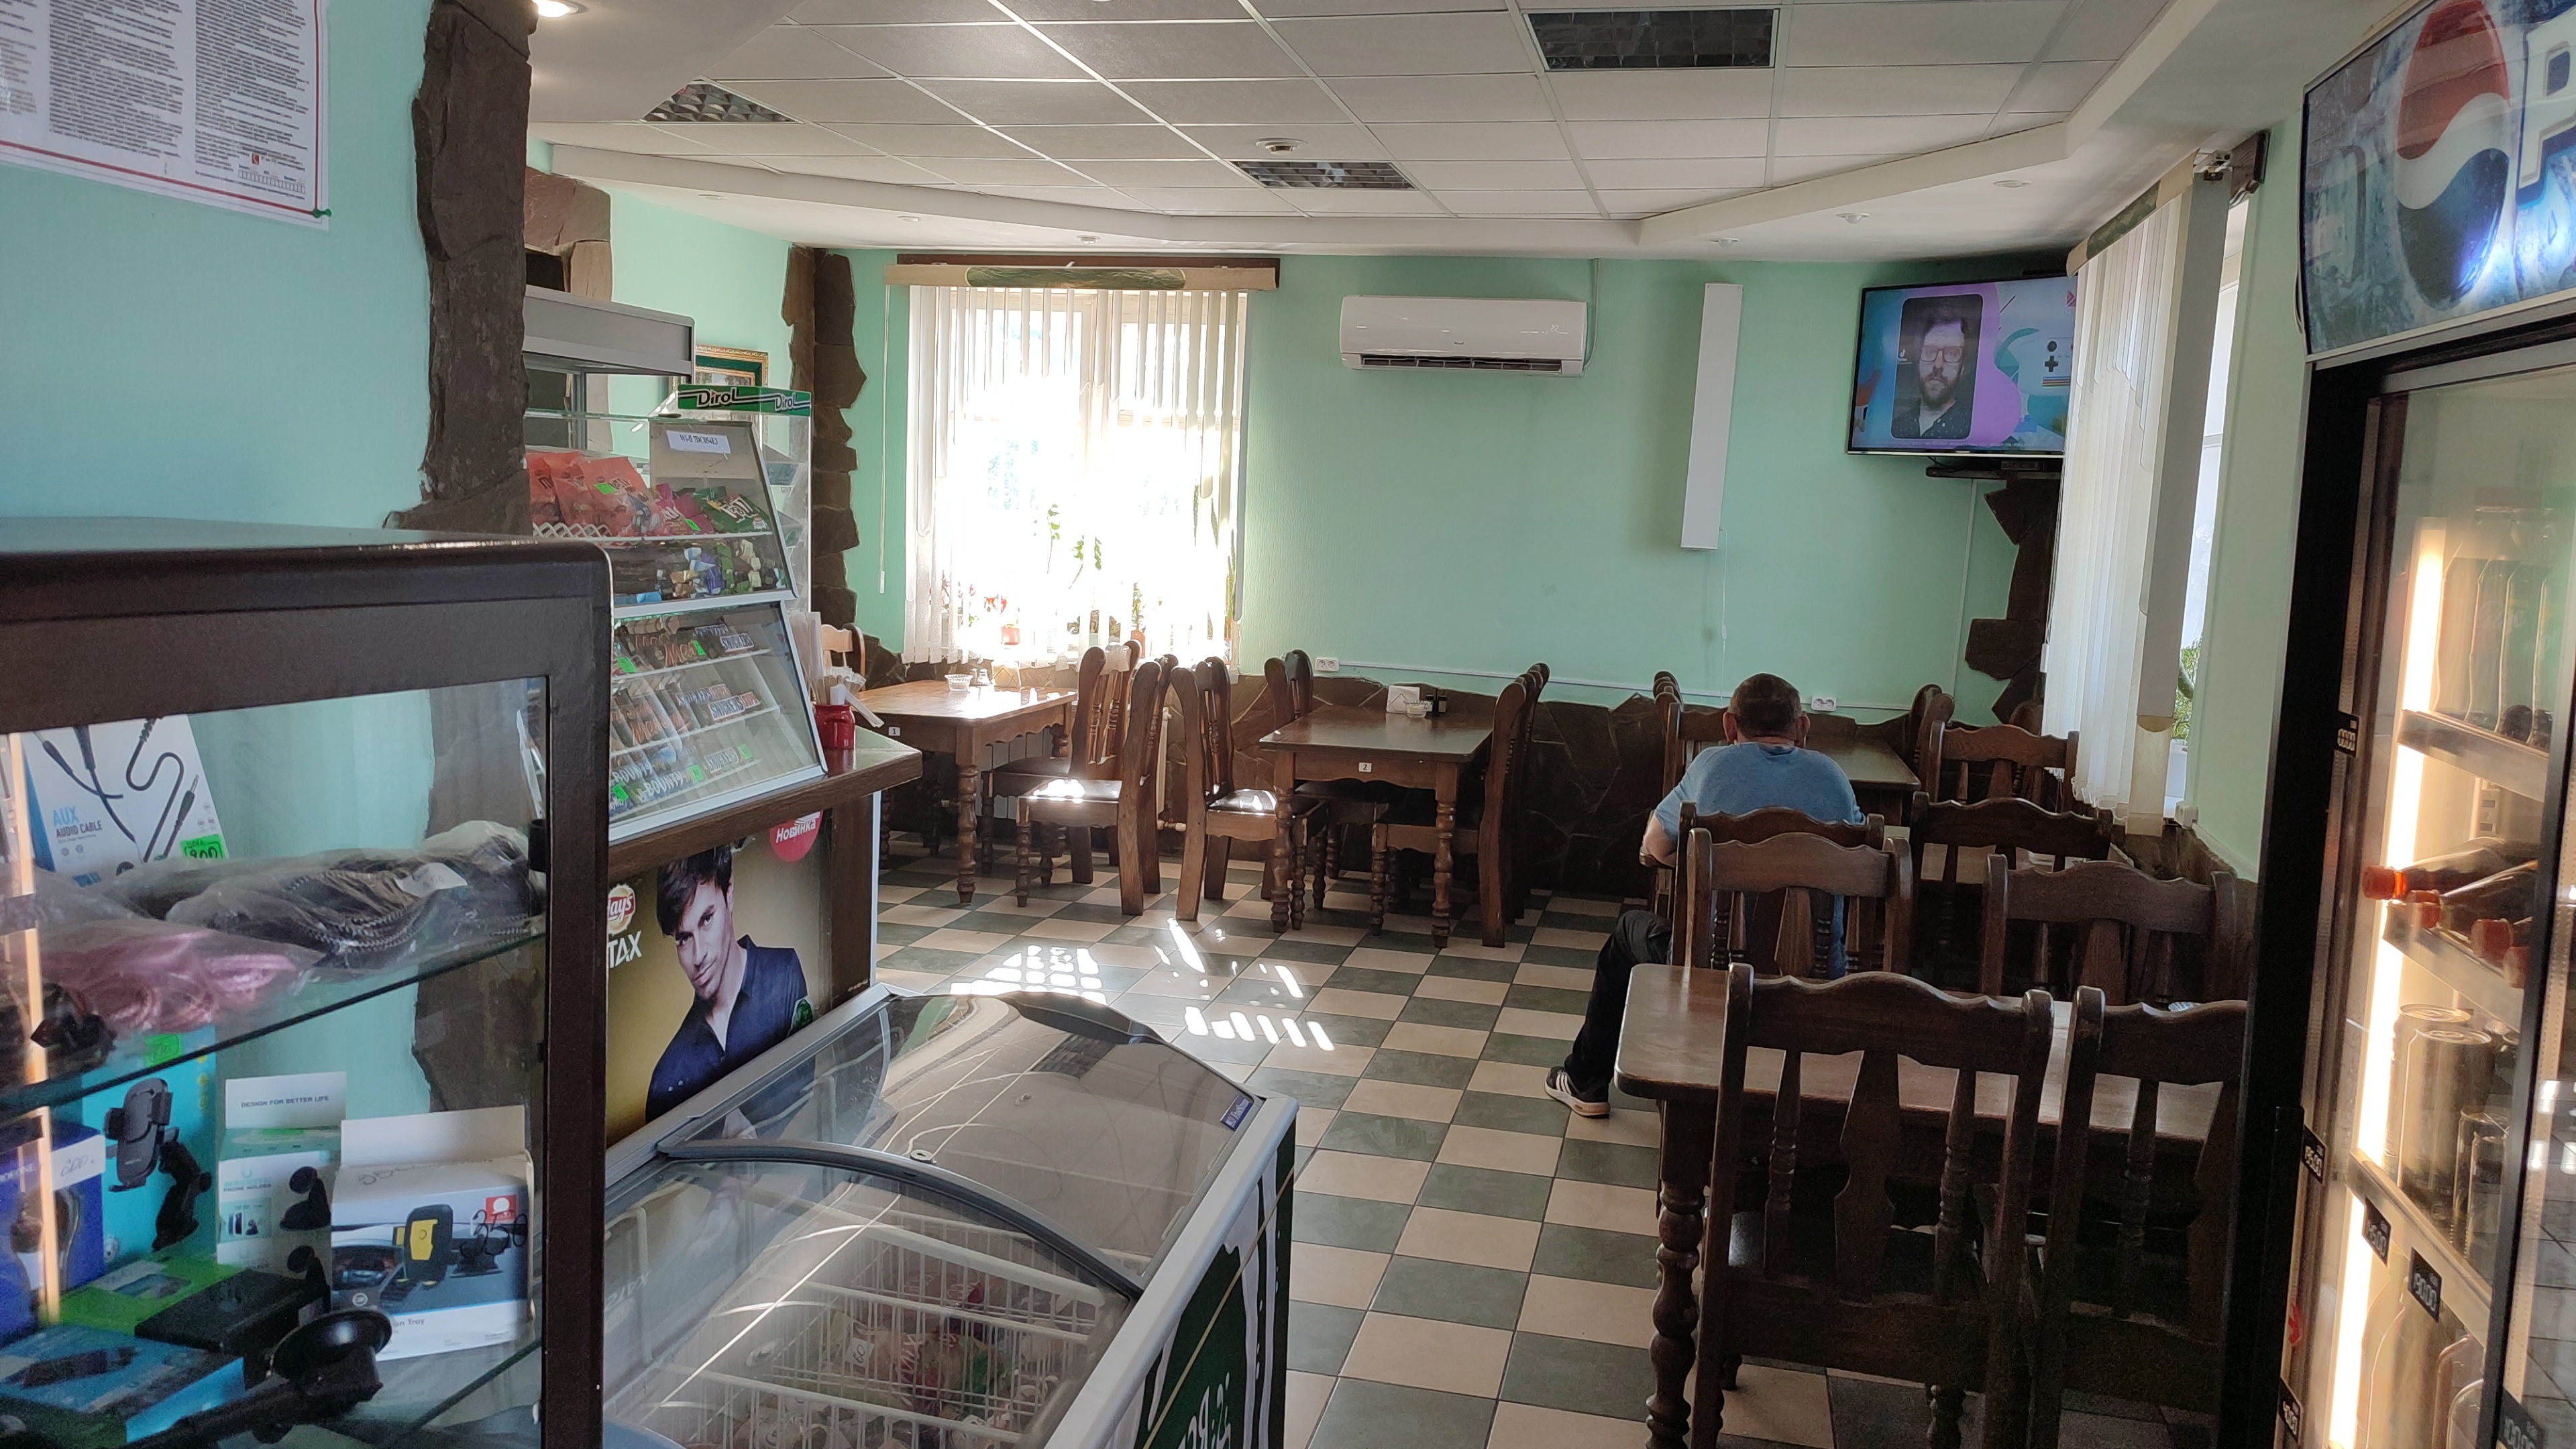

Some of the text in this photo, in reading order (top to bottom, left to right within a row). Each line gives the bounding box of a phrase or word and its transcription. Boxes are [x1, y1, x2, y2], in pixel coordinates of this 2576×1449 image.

[708, 696, 745, 721] SNICKERS
[643, 770, 684, 798] BOUNTY
[52, 806, 79, 827] AUX
[56, 820, 103, 839] AUDIO CABLE
[241, 1100, 268, 1108] DESIGN
[459, 1209, 528, 1258] 350
